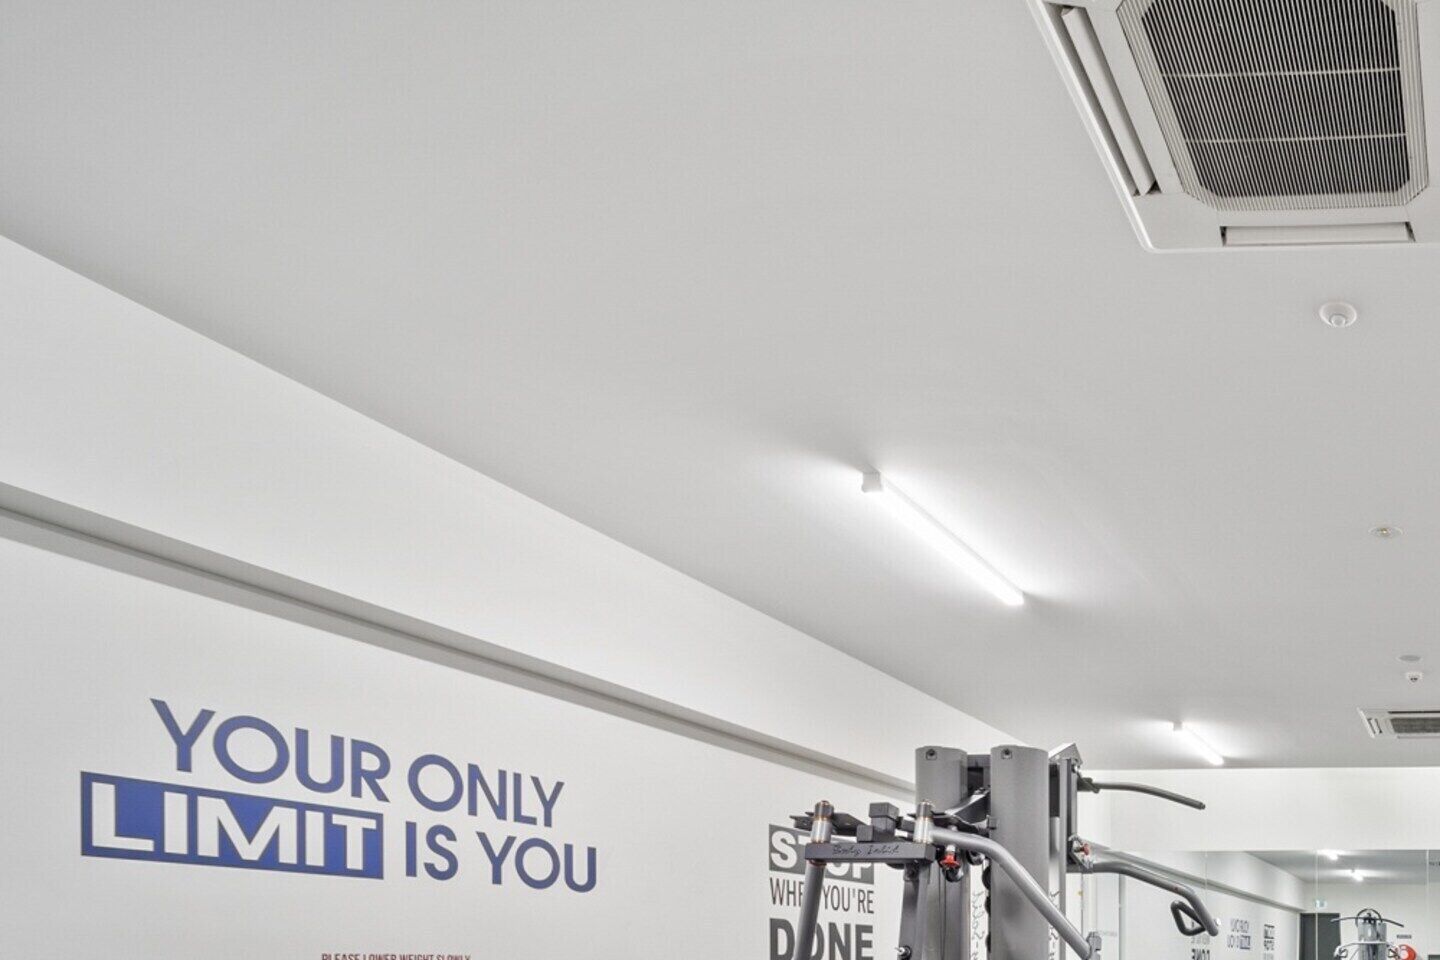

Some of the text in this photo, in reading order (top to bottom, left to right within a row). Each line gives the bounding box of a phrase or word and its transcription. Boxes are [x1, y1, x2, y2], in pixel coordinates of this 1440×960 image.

[149, 697, 565, 828] YOUR ONLY
[90, 781, 598, 894] LIMIT IS YOU
[770, 829, 872, 879] SP
[823, 884, 875, 914] YOU'RE
